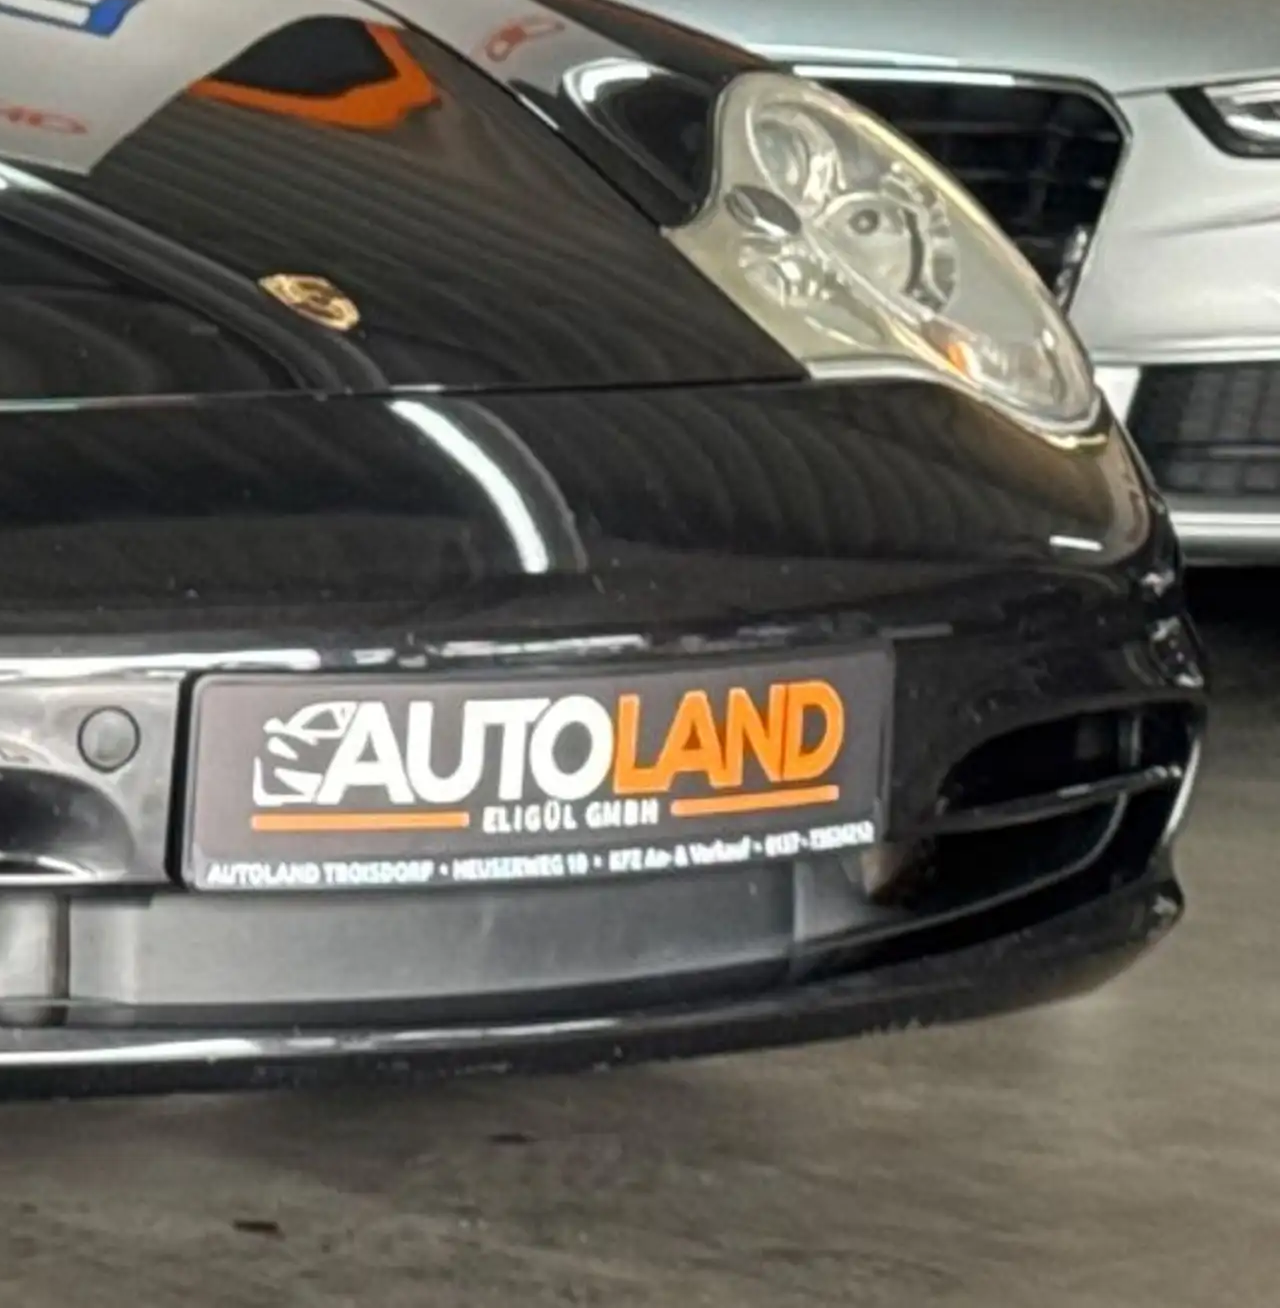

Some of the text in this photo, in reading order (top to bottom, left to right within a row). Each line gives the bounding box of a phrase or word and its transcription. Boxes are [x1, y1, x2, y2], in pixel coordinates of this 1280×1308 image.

[317, 680, 845, 804] AUTOLAND
[207, 861, 320, 886] AUTOLAND
[324, 859, 435, 884] TROISDORF
